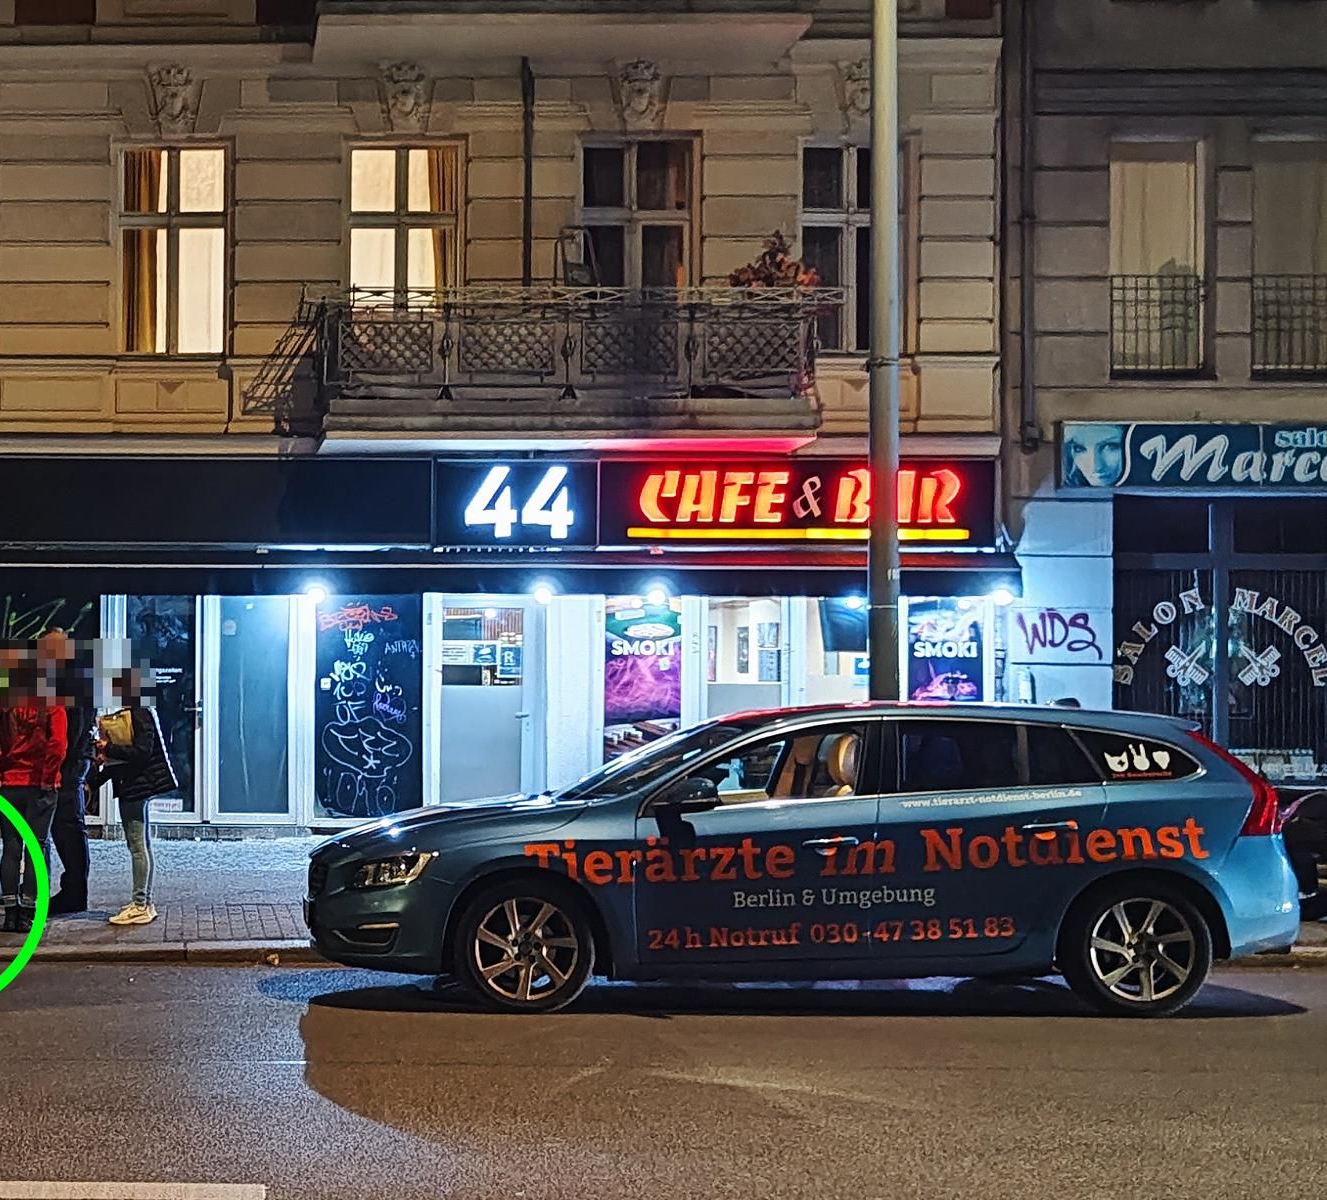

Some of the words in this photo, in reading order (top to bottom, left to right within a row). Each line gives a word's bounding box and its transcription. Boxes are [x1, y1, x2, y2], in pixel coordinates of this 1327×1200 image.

[1140, 434, 1327, 483] Marc
[465, 466, 573, 538] 44
[639, 471, 789, 523] CAFE
[792, 476, 821, 518] &
[611, 640, 675, 656] SMOKI
[913, 641, 978, 658] SMOKI
[1017, 609, 1103, 661] WDS
[1114, 588, 1205, 685] SALON
[524, 837, 795, 885] Tierärzte
[820, 840, 895, 876] im
[920, 818, 1209, 872] Notdienst
[733, 890, 795, 908] Berlin
[802, 889, 815, 906] &
[822, 886, 936, 909] Umgebung
[648, 929, 680, 949] 24
[684, 927, 703, 948] h
[708, 922, 801, 947] Notruf
[910, 919, 942, 941] 38
[947, 917, 978, 939] 51
[983, 915, 1015, 938] 83
